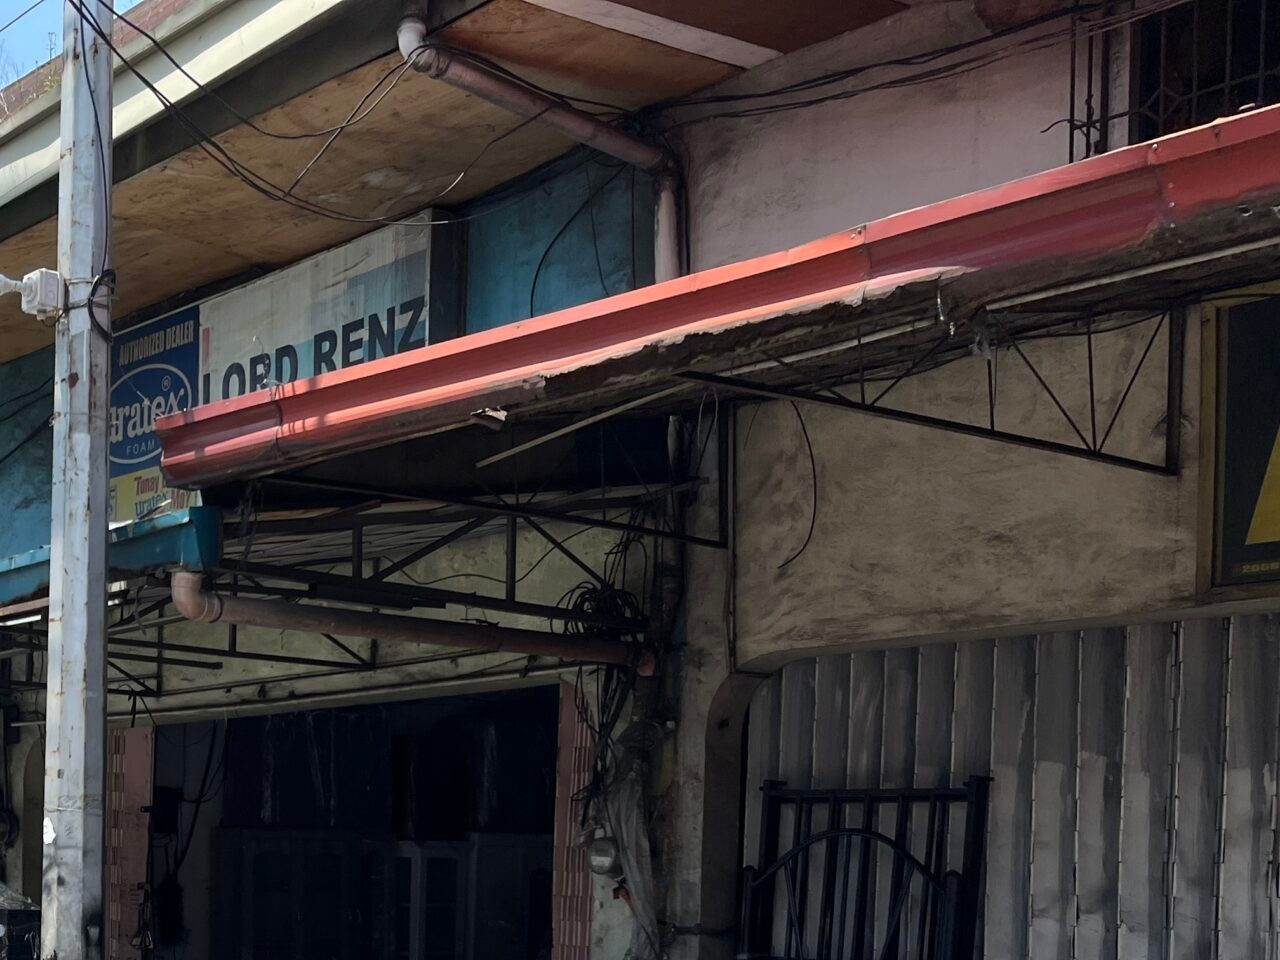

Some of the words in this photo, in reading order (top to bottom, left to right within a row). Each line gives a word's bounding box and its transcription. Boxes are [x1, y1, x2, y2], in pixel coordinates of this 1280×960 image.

[119, 329, 165, 366] AUTHORIZED
[166, 320, 195, 350] DEALER
[313, 296, 426, 373] RENZ
[126, 440, 155, 456] FOAM
